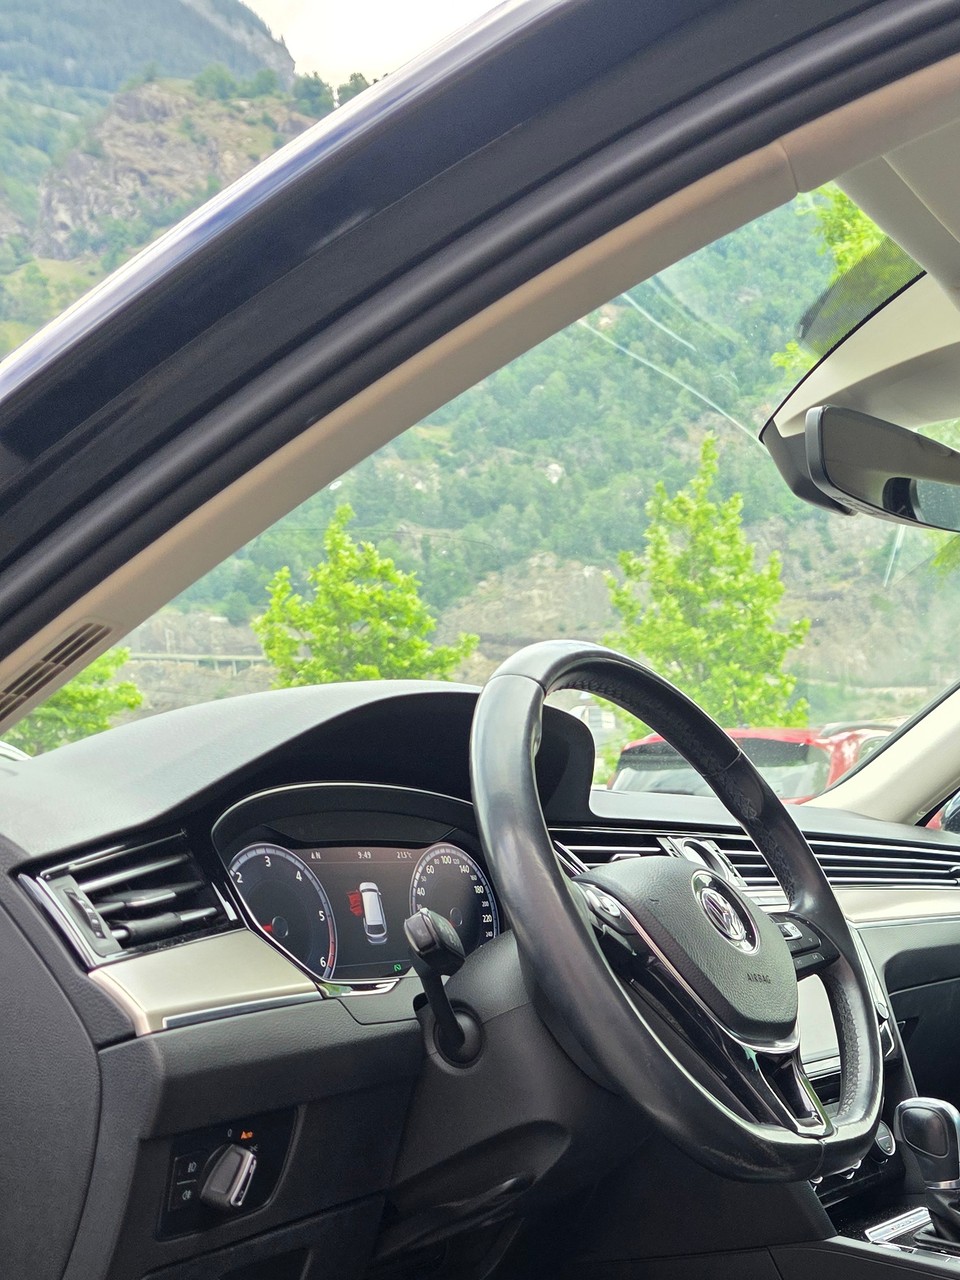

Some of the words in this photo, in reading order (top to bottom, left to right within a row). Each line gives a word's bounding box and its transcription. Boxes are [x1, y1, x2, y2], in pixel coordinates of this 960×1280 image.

[357, 851, 371, 859] 9:49
[440, 855, 452, 864] 100
[264, 855, 272, 867] 3
[426, 865, 435, 874] 60
[459, 865, 470, 874] 140
[235, 871, 243, 883] 2
[295, 870, 302, 881] 4
[416, 887, 426, 896] 40
[474, 885, 484, 894] 180
[318, 910, 325, 921] 5
[482, 914, 492, 923] 220
[319, 956, 326, 967] 6
[746, 972, 771, 984] AIRBAG
